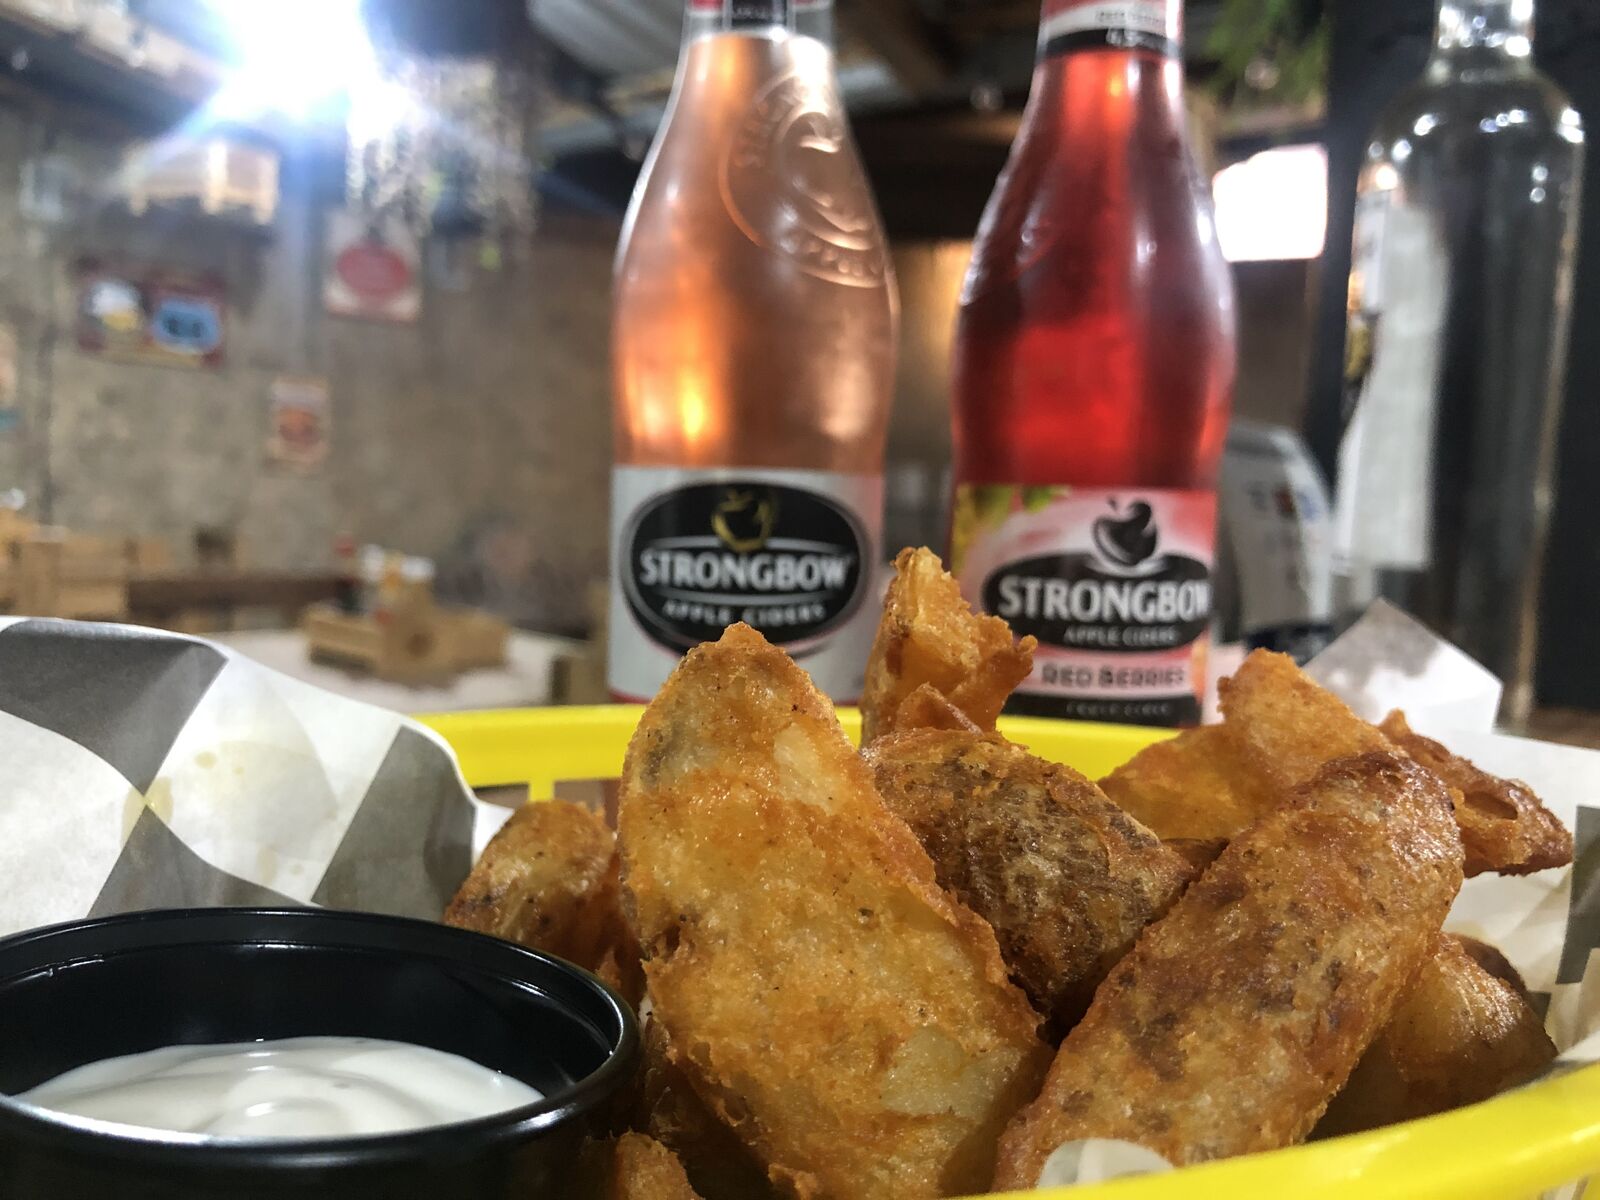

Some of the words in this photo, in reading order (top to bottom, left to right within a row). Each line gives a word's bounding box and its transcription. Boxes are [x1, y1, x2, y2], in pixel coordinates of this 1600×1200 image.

[640, 549, 847, 591] STRONGBOW
[996, 574, 1211, 623] STRONGBOW
[662, 599, 731, 625] APPLE
[1064, 626, 1119, 646] APPLE
[1042, 663, 1092, 687] RED
[1099, 665, 1185, 687] BERRIES
